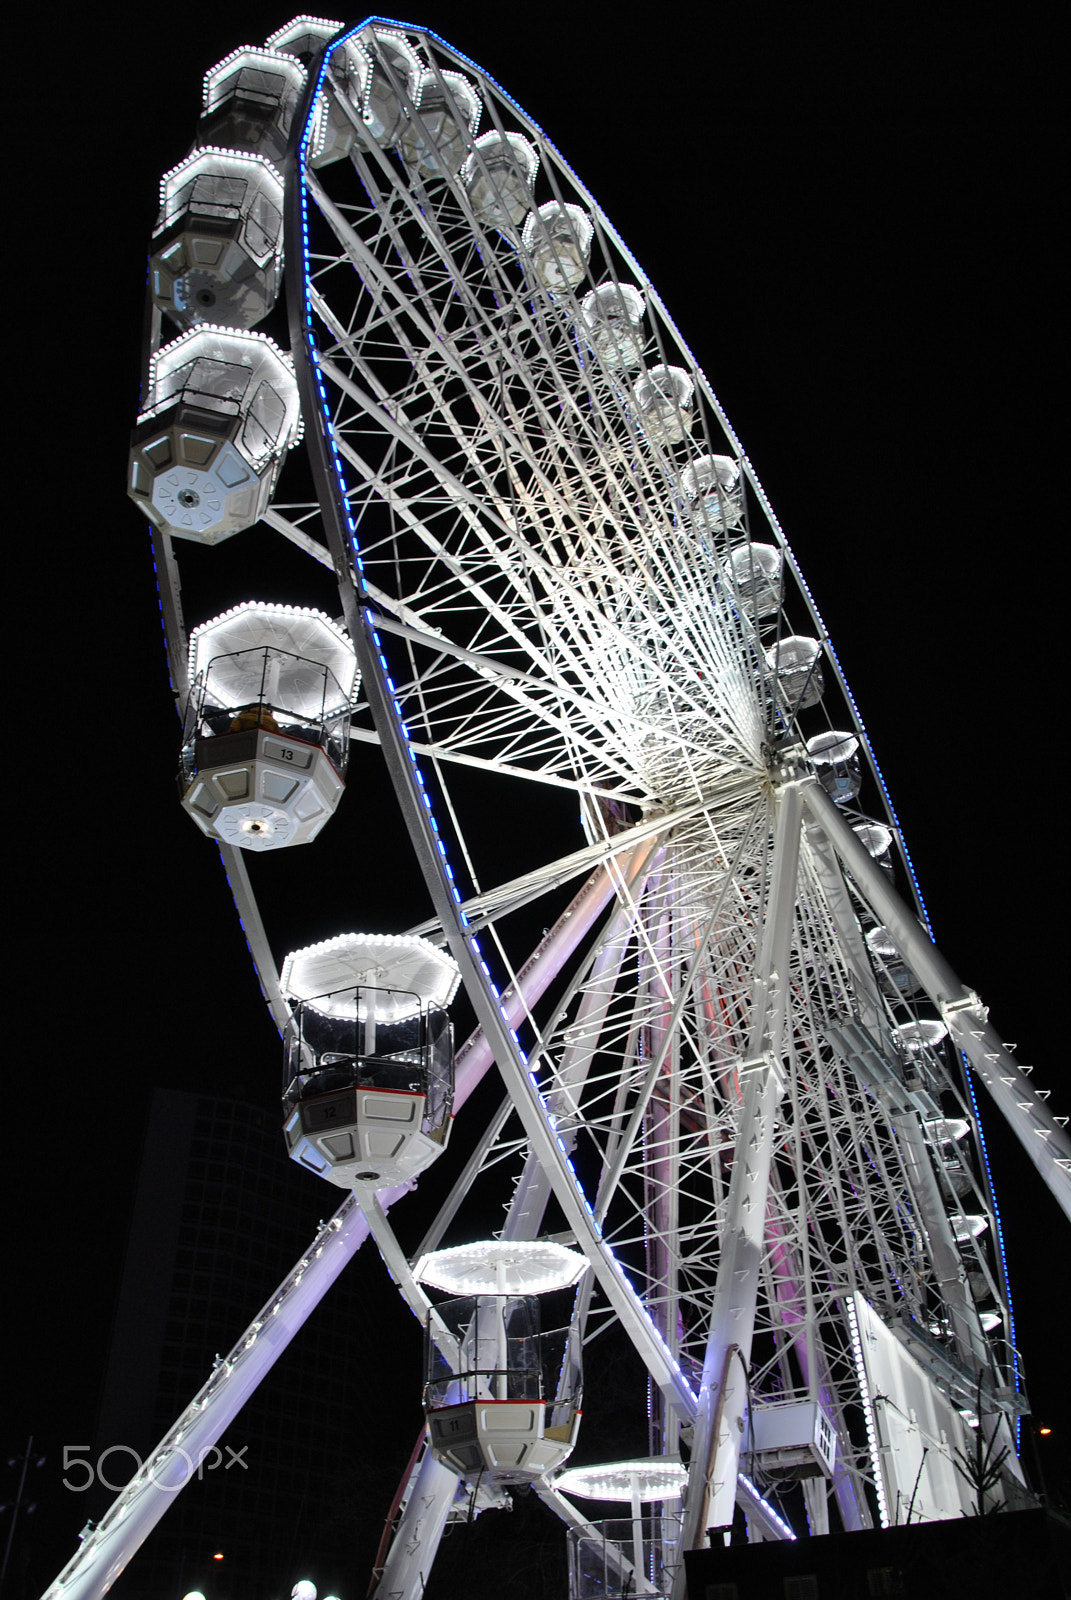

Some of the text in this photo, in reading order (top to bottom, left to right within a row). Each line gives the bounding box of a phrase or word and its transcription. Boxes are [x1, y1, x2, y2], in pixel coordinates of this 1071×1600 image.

[280, 748, 294, 761] 13
[324, 1106, 337, 1118] 12
[449, 1420, 460, 1431] 11
